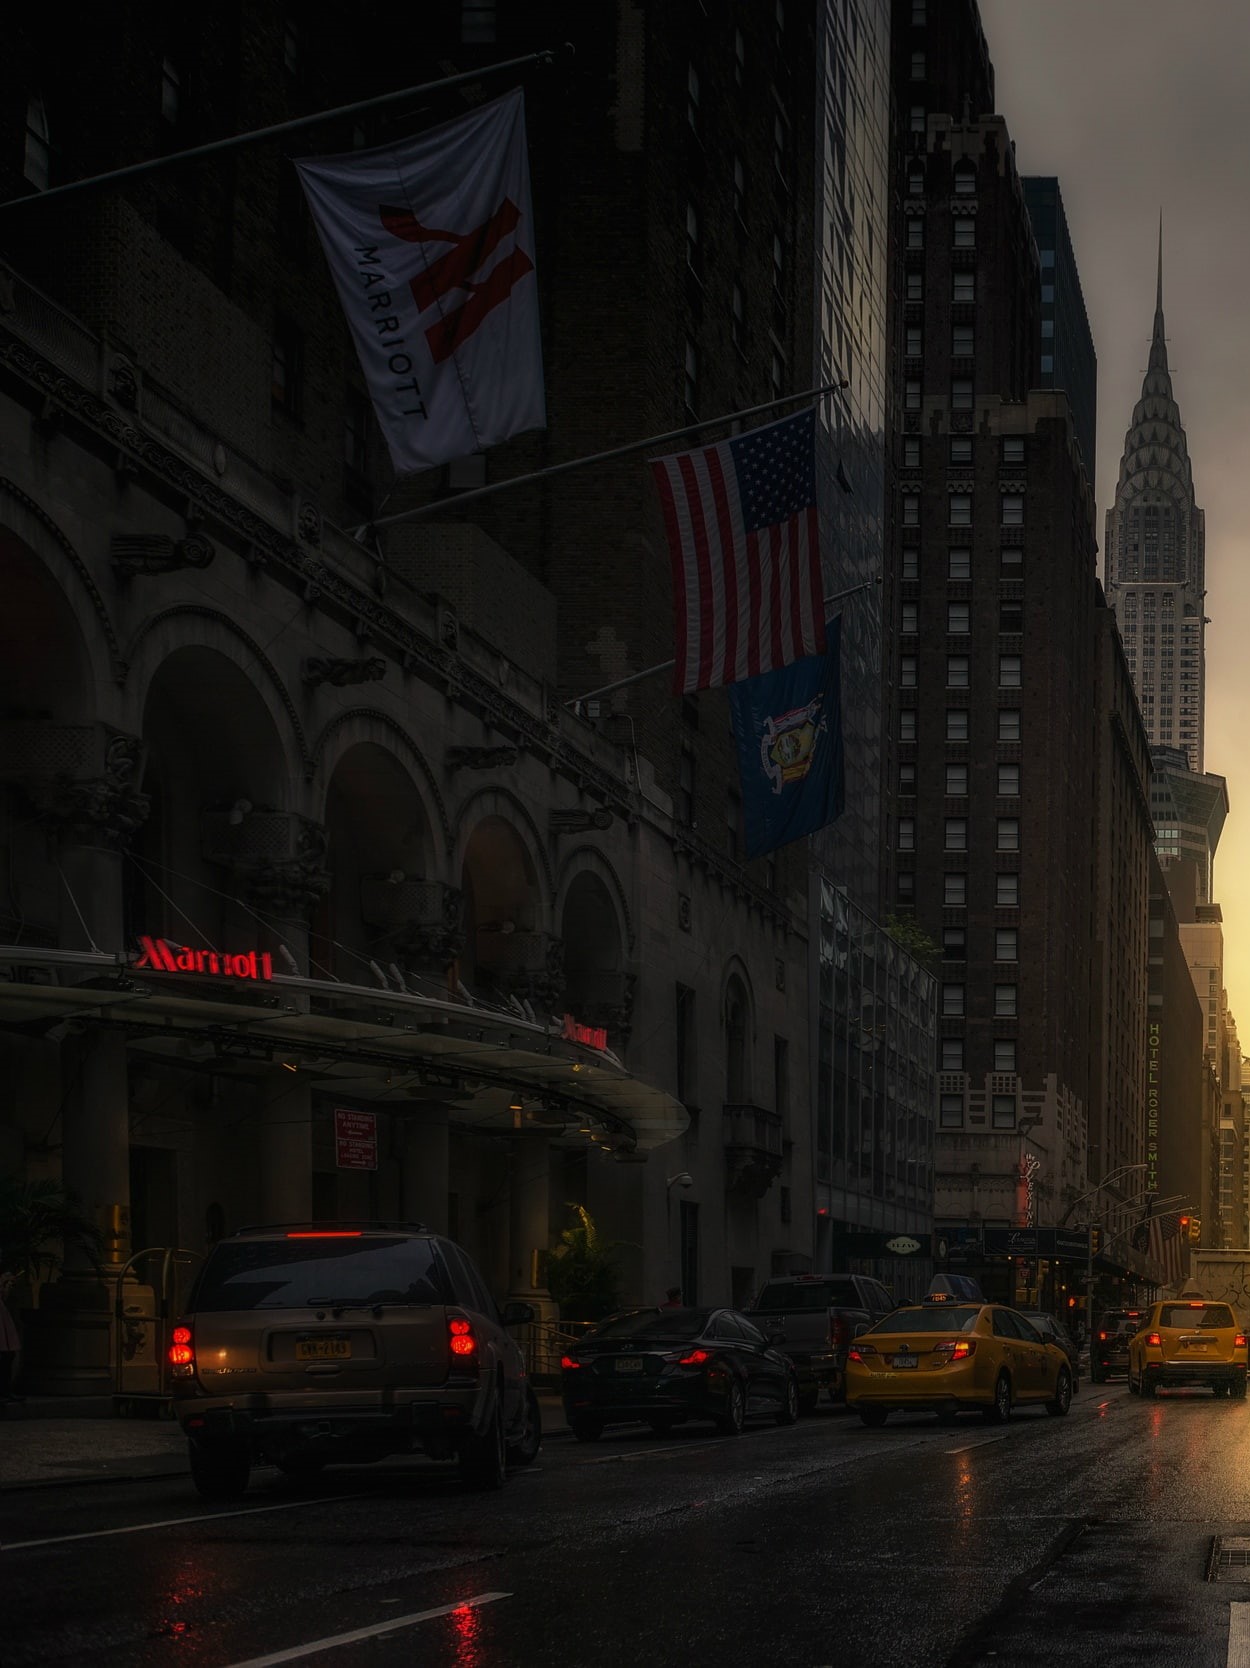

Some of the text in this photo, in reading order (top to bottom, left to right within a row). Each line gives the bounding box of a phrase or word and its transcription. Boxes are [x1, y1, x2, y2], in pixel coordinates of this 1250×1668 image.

[354, 246, 428, 419] MARRIOTT
[134, 935, 273, 981] Marriott
[337, 1112, 346, 1120] NO
[342, 1121, 370, 1130] ANYTIME
[1147, 1023, 1159, 1189] HOTEL ROGER SMITH
[1020, 1161, 1040, 1228] LEXING
